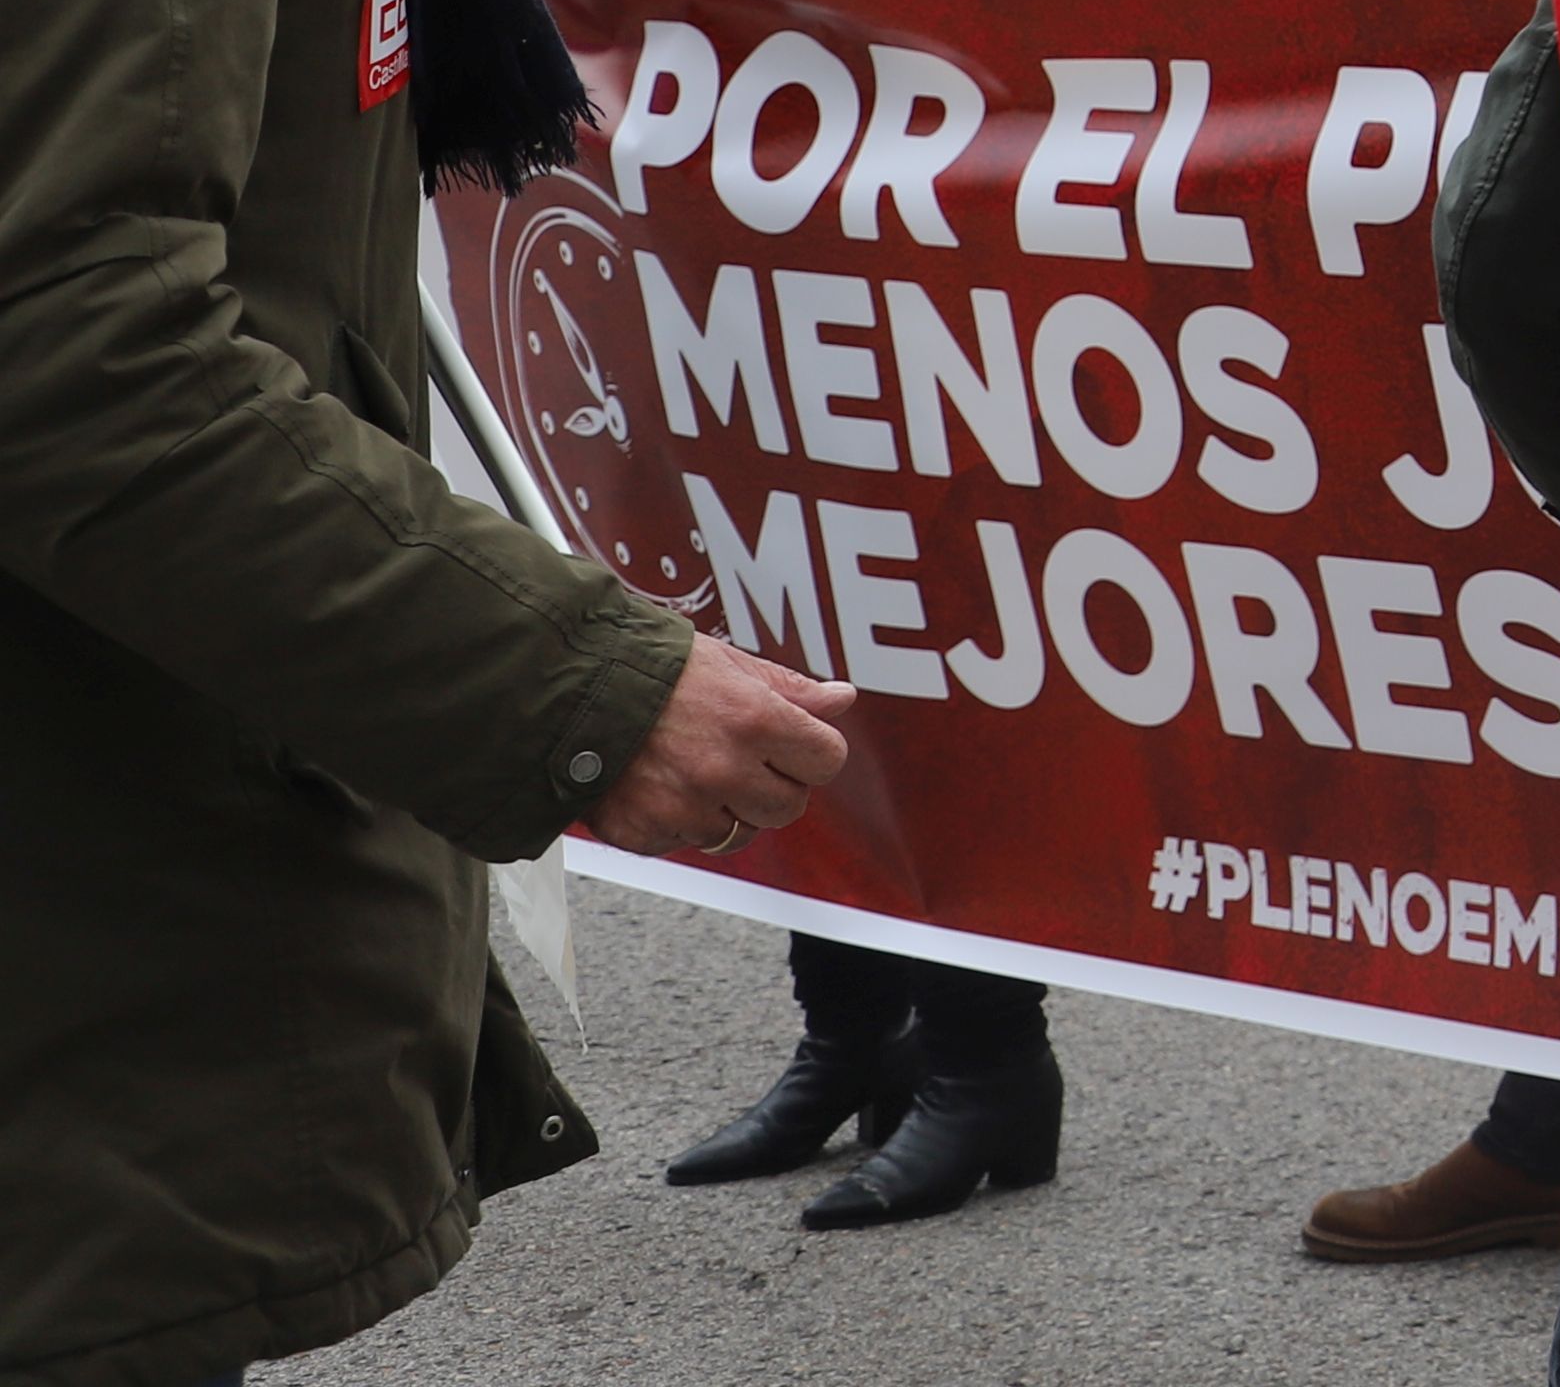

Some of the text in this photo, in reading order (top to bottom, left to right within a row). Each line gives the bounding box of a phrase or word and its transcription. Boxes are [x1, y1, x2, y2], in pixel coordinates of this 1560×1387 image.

[611, 19, 986, 248] POR
[1014, 58, 1253, 271] EL
[633, 247, 1319, 517] MENOS
